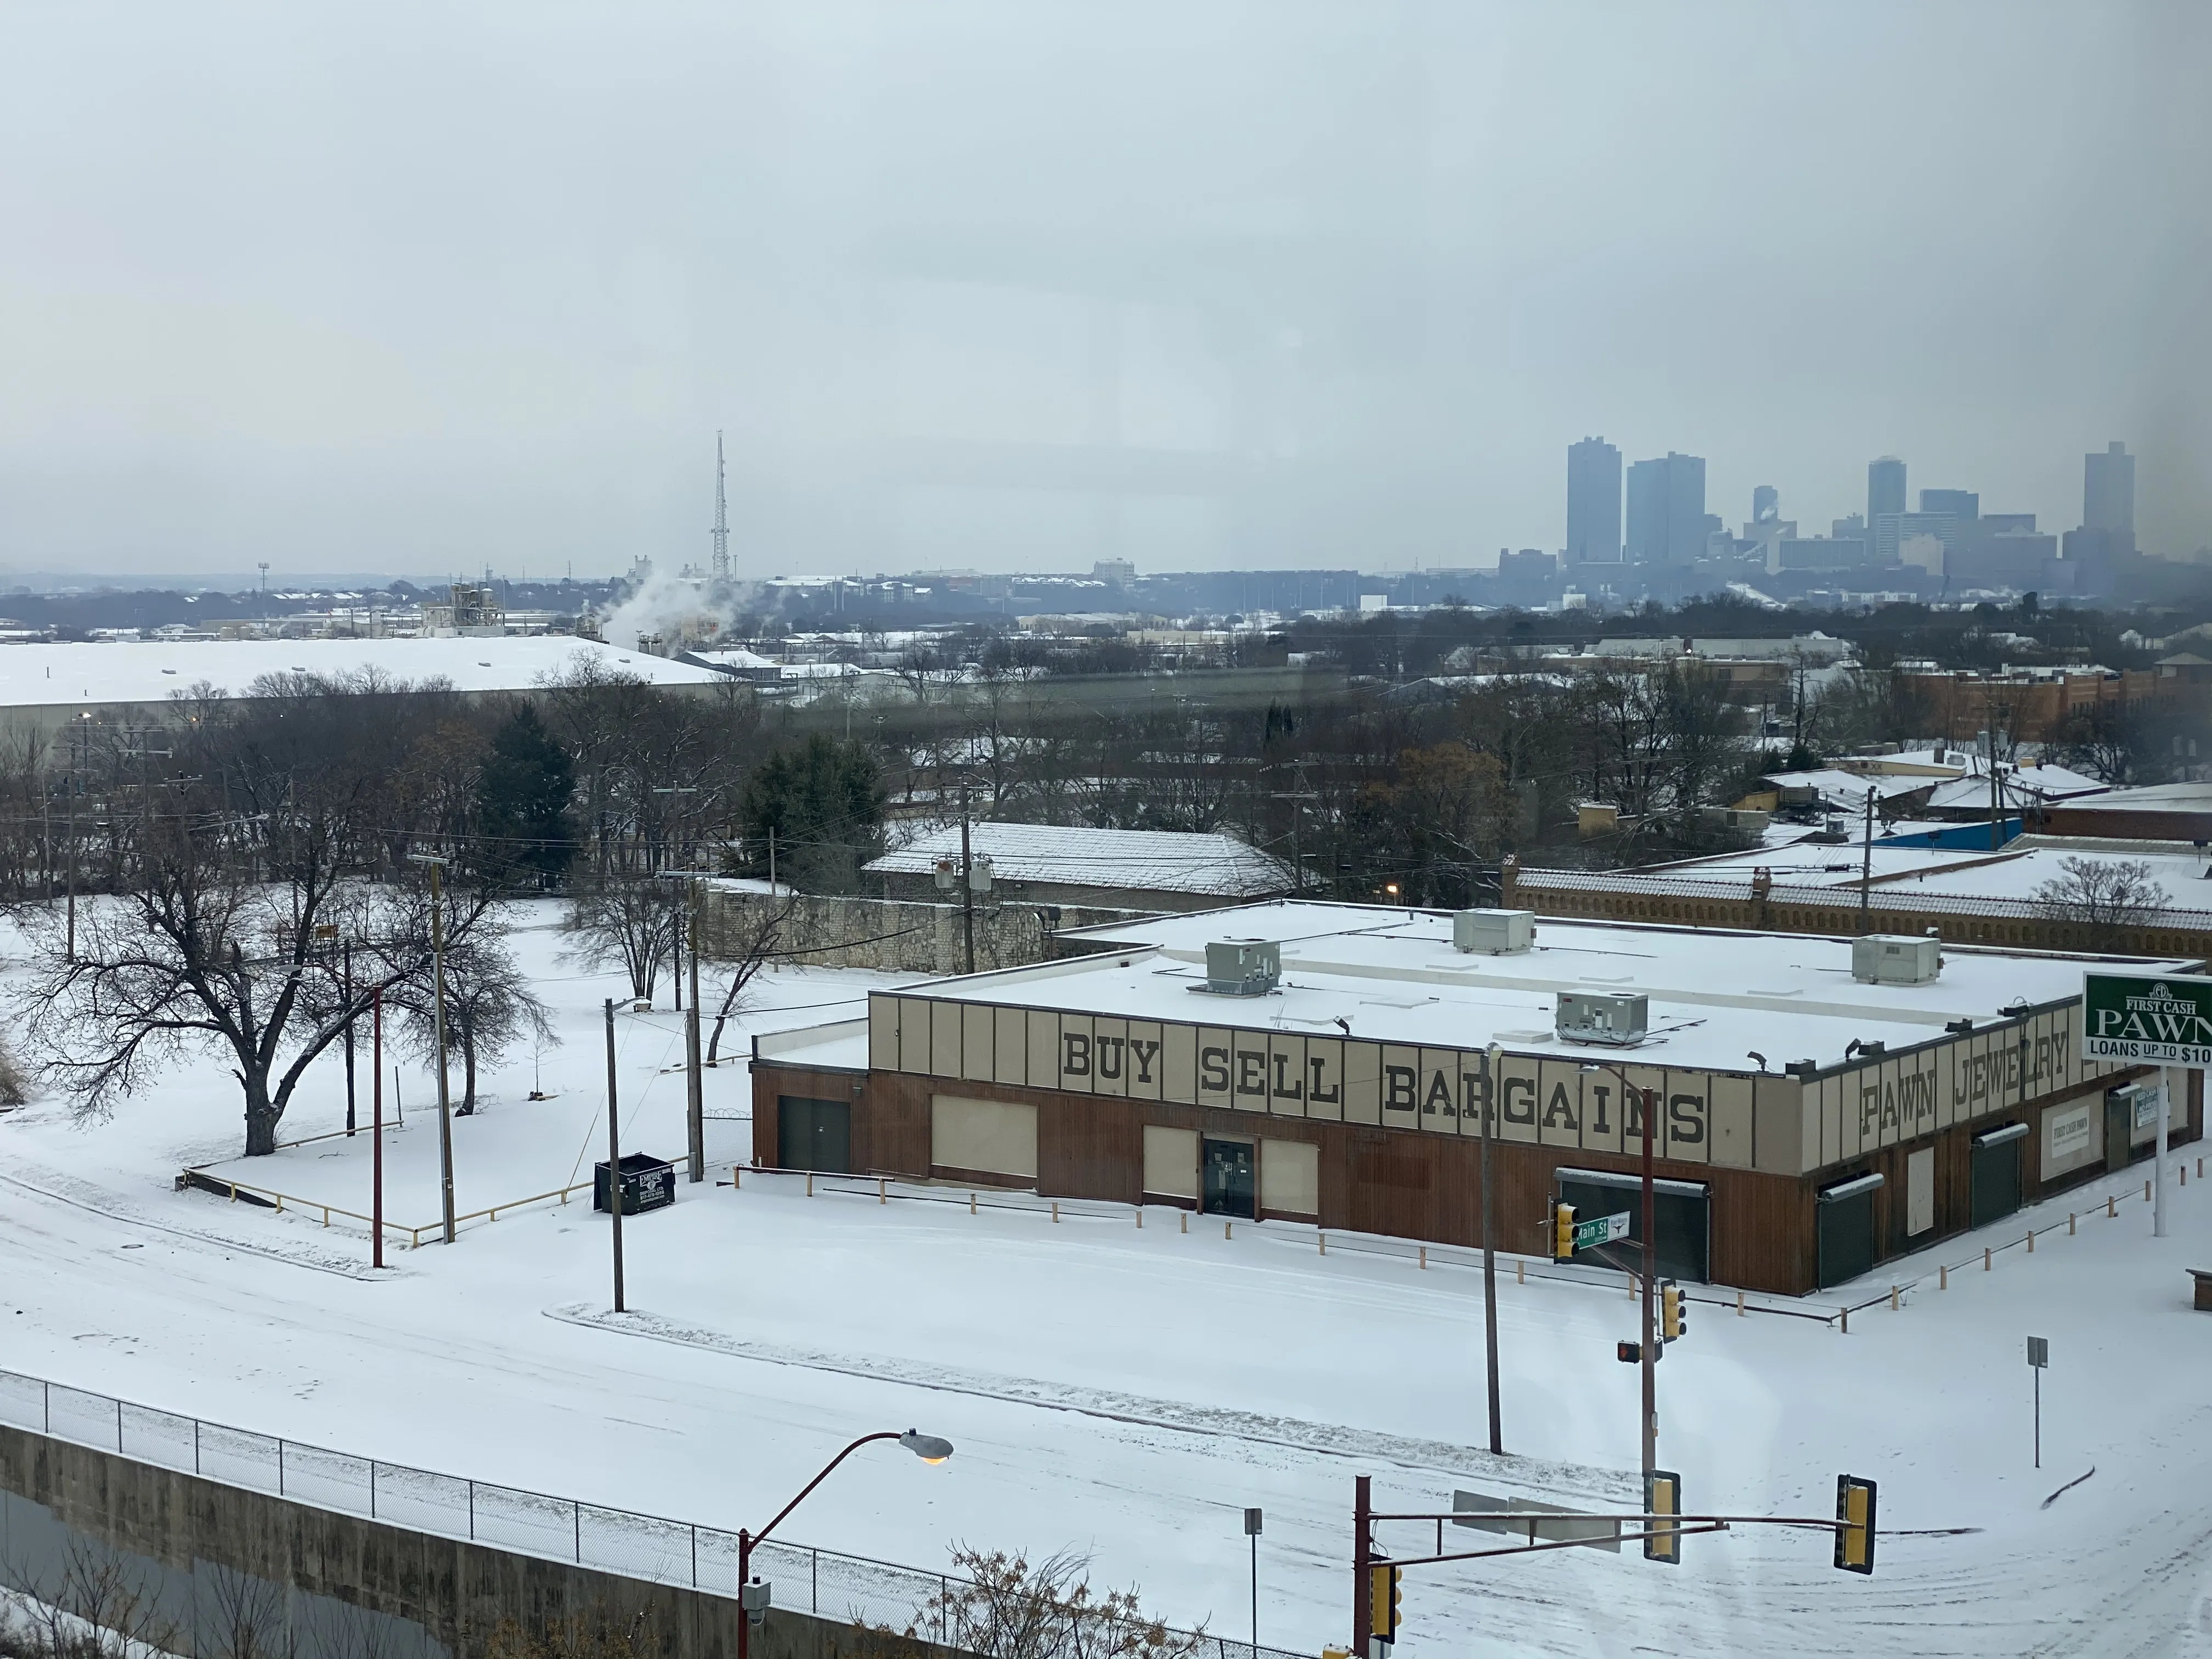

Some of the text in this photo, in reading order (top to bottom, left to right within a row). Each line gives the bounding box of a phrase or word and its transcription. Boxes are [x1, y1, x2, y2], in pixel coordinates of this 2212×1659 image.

[2126, 999, 2196, 1015] FIRST CASH
[2090, 1040, 2139, 1057] LOANS
[2143, 1043, 2159, 1055] UP
[2162, 1045, 2176, 1057] TO
[1063, 1032, 1704, 1143] BUY SELL BARGAINS
[1863, 1031, 2067, 1136] PAWN JEWELRY
[640, 1170, 662, 1187] EMPIRE
[1599, 1221, 1607, 1234] St
